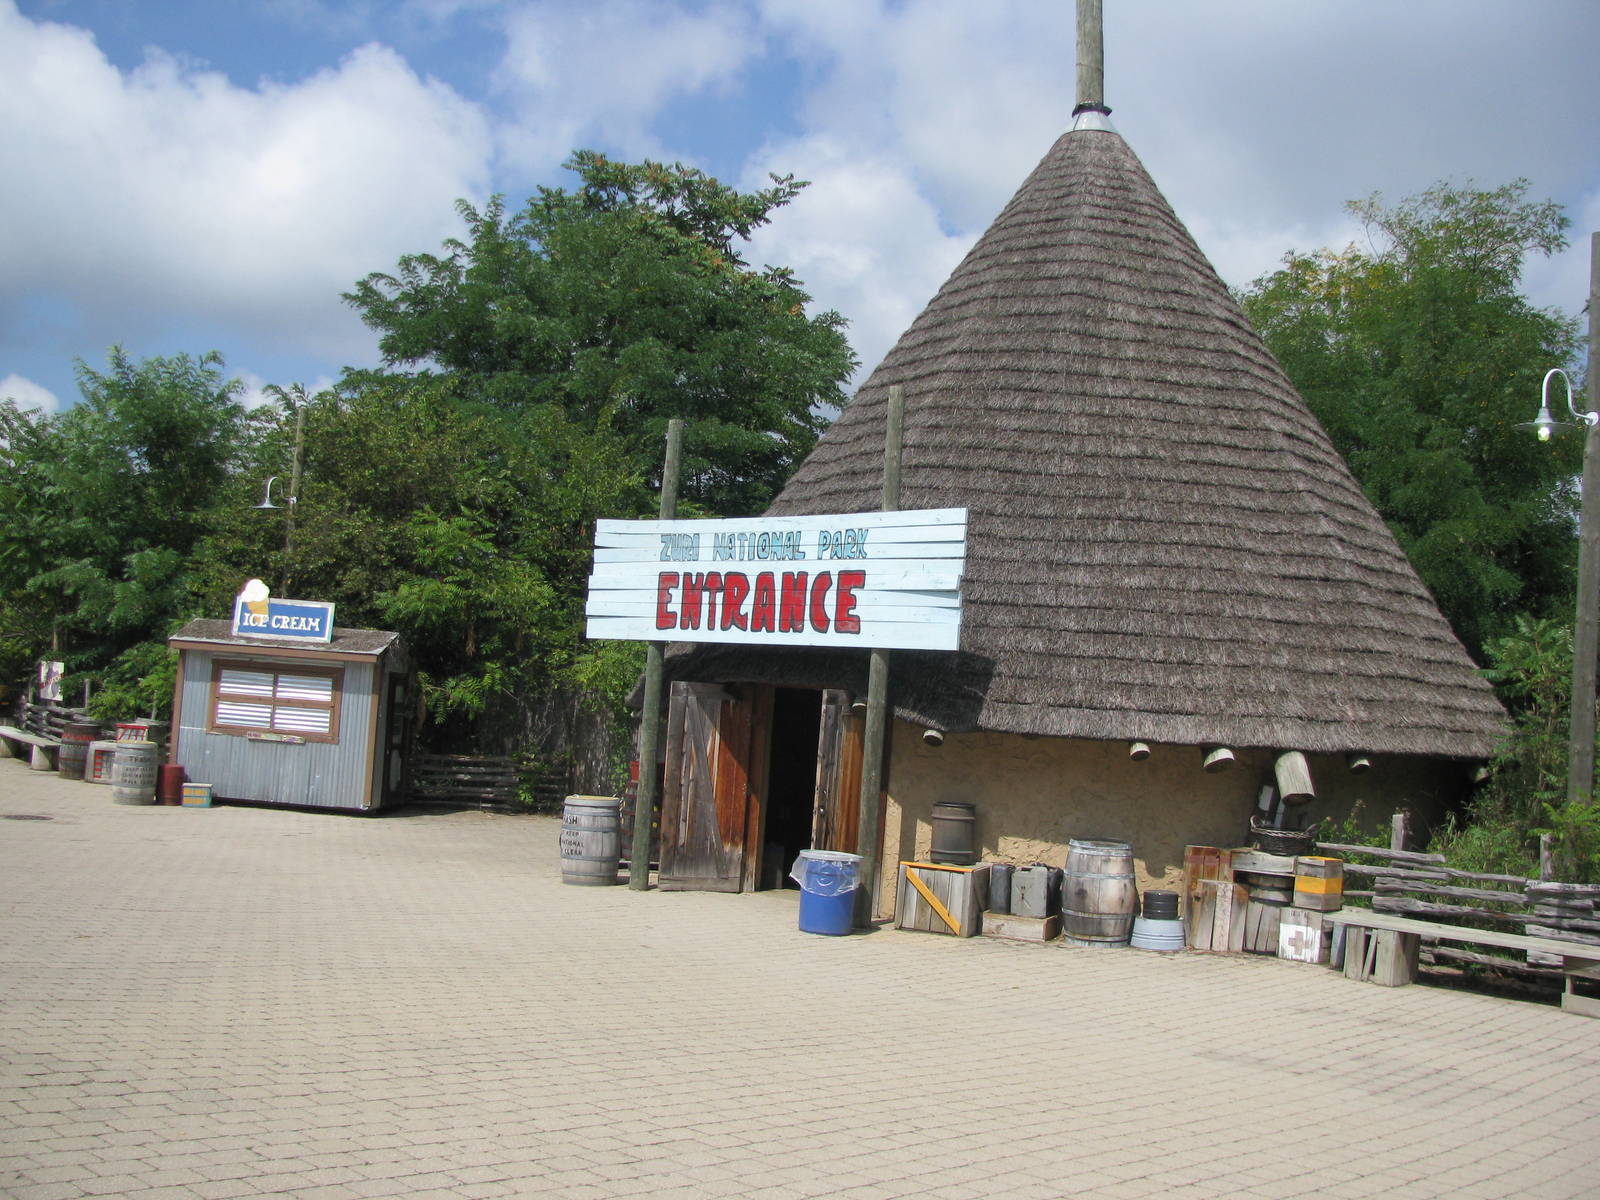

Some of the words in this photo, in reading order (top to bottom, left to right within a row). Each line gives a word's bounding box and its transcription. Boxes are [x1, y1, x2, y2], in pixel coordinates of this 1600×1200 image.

[660, 532, 700, 561] ZURI
[712, 531, 806, 561] NATIONAL
[817, 529, 869, 560] PARK
[656, 570, 866, 634] ENTRANCE
[243, 613, 267, 627] ICE
[271, 615, 320, 631] CREAM
